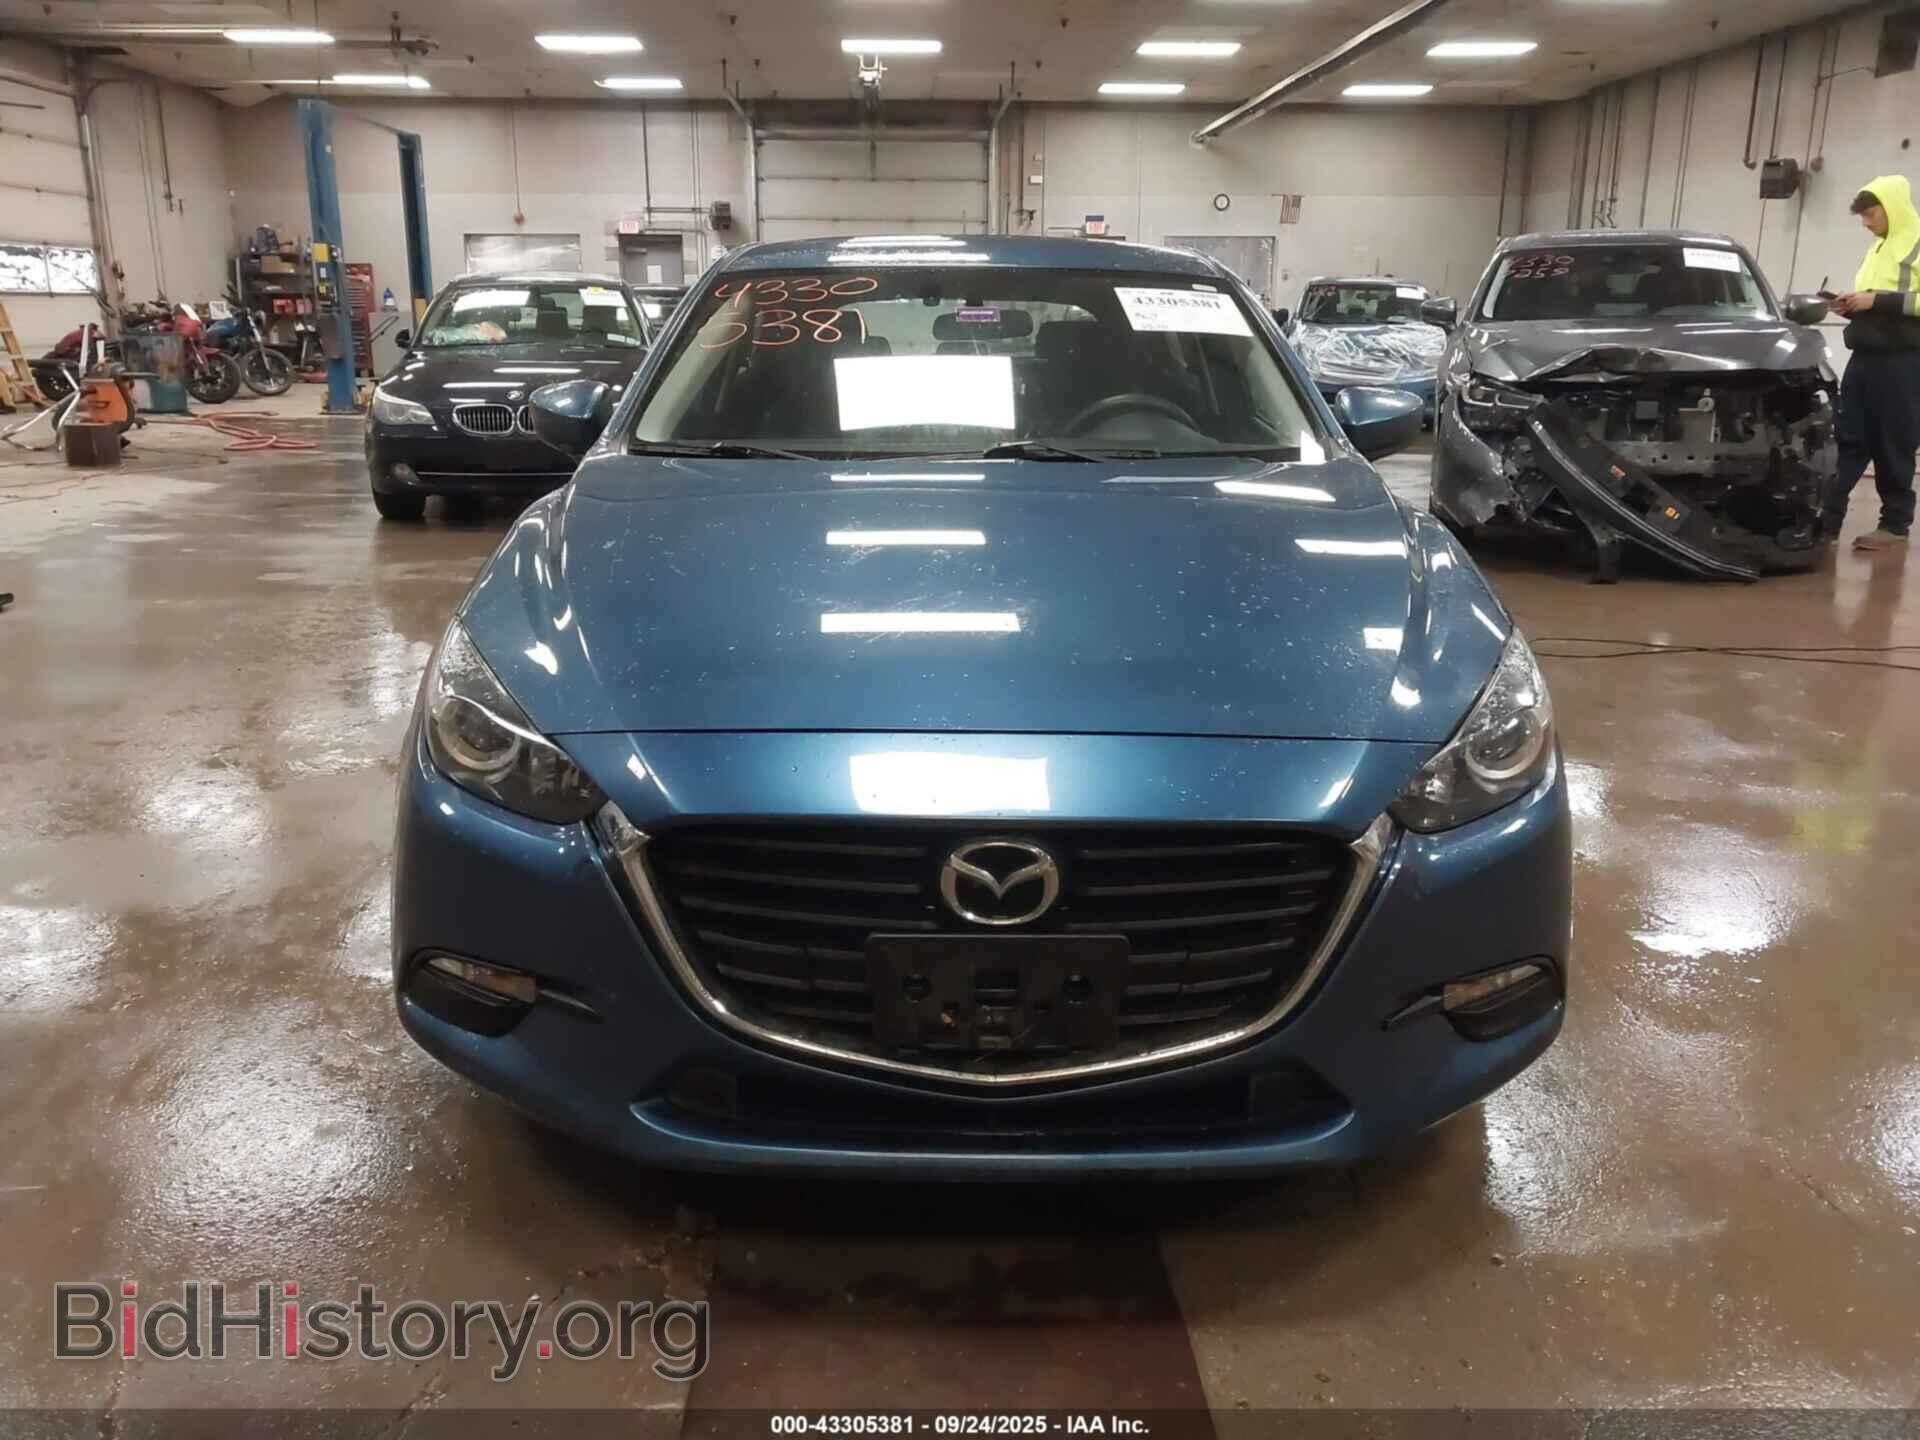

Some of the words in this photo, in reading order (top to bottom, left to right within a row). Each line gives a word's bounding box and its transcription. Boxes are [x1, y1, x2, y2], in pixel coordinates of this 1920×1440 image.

[714, 276, 878, 309] 4330
[1133, 296, 1223, 310] 43305381
[697, 308, 867, 349] 5381
